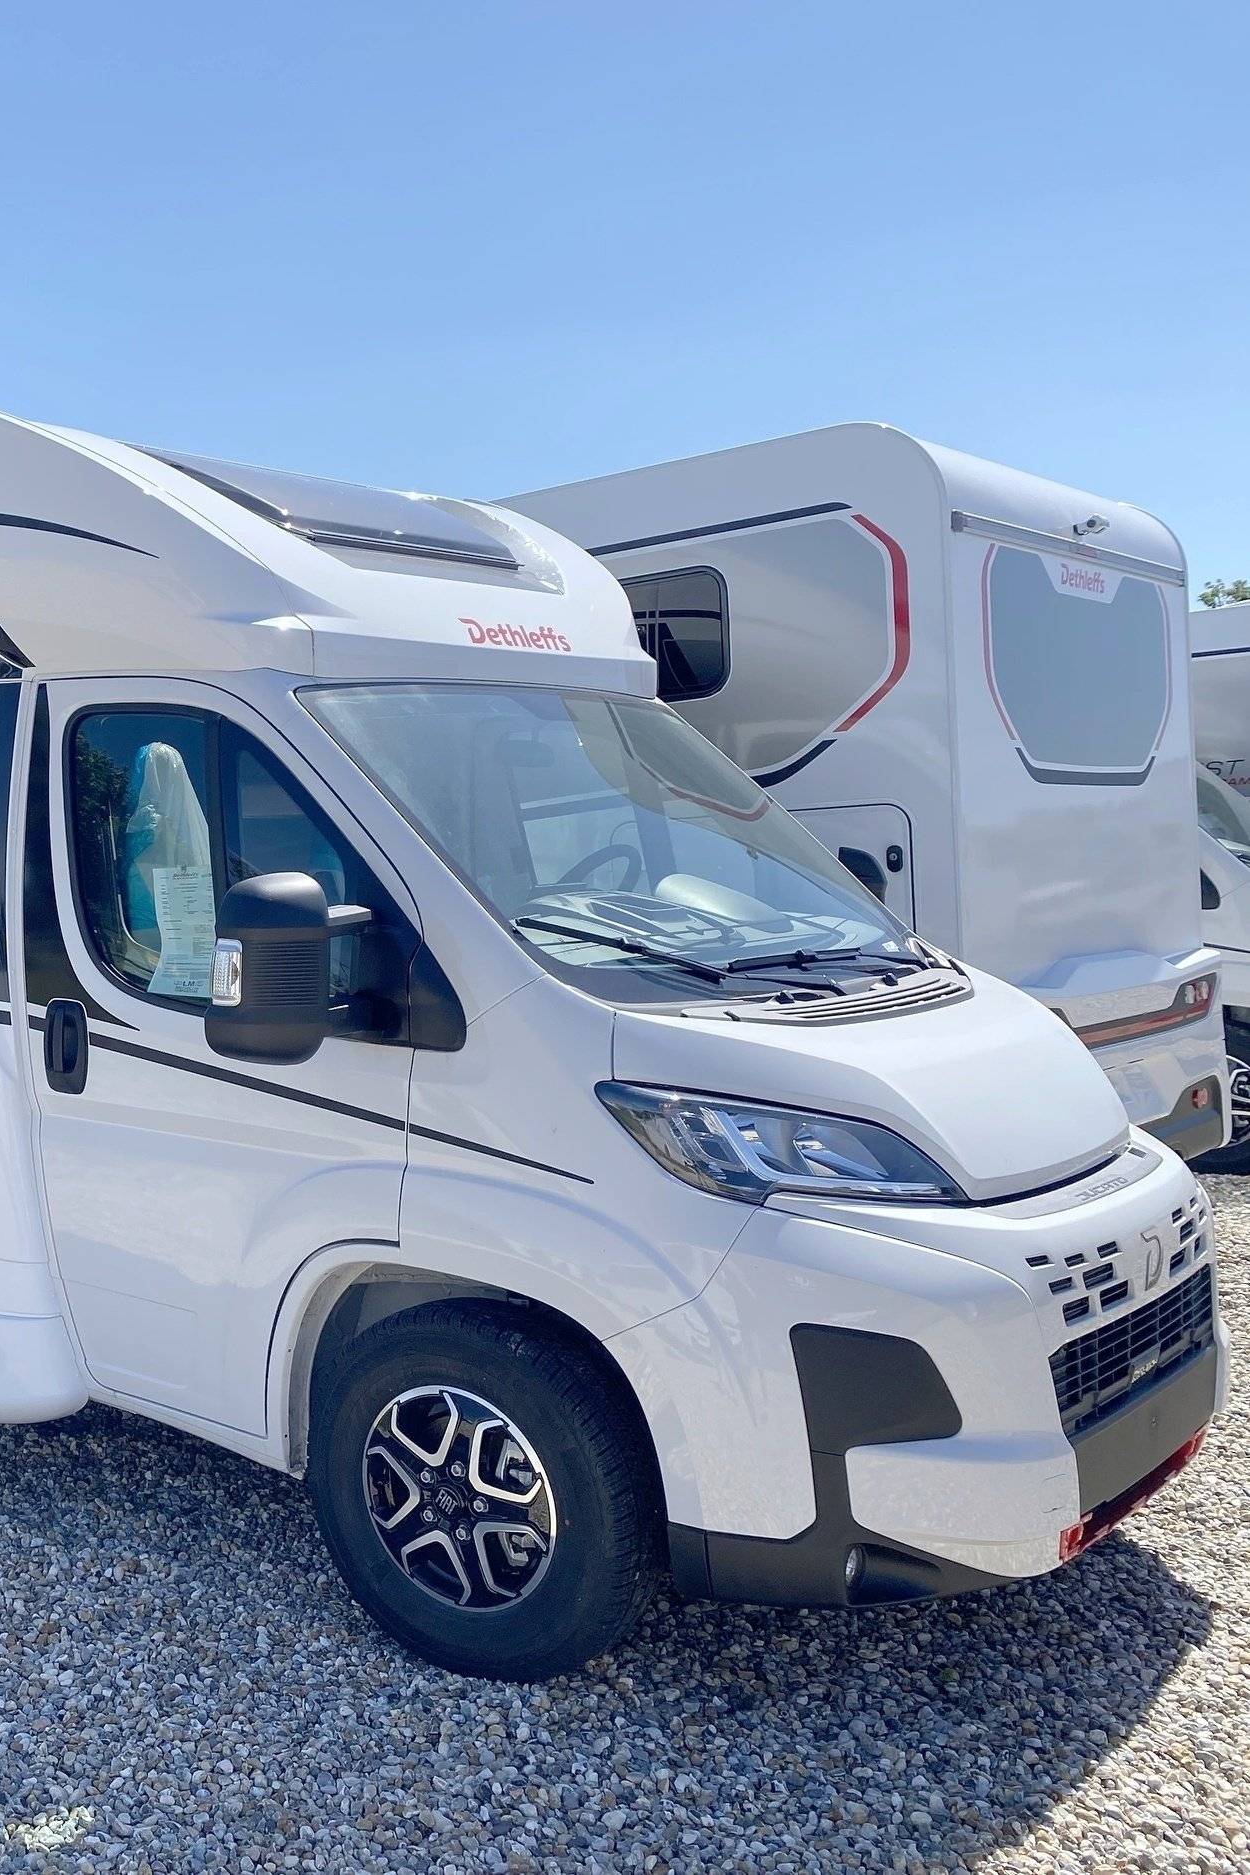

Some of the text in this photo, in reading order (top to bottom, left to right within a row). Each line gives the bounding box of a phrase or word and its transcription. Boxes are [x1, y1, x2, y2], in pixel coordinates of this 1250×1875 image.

[1060, 563, 1105, 593] Dethleffs
[456, 617, 572, 652] Dethleffs
[1075, 1177, 1129, 1201] DUCATO
[435, 1489, 458, 1515] FIAT
